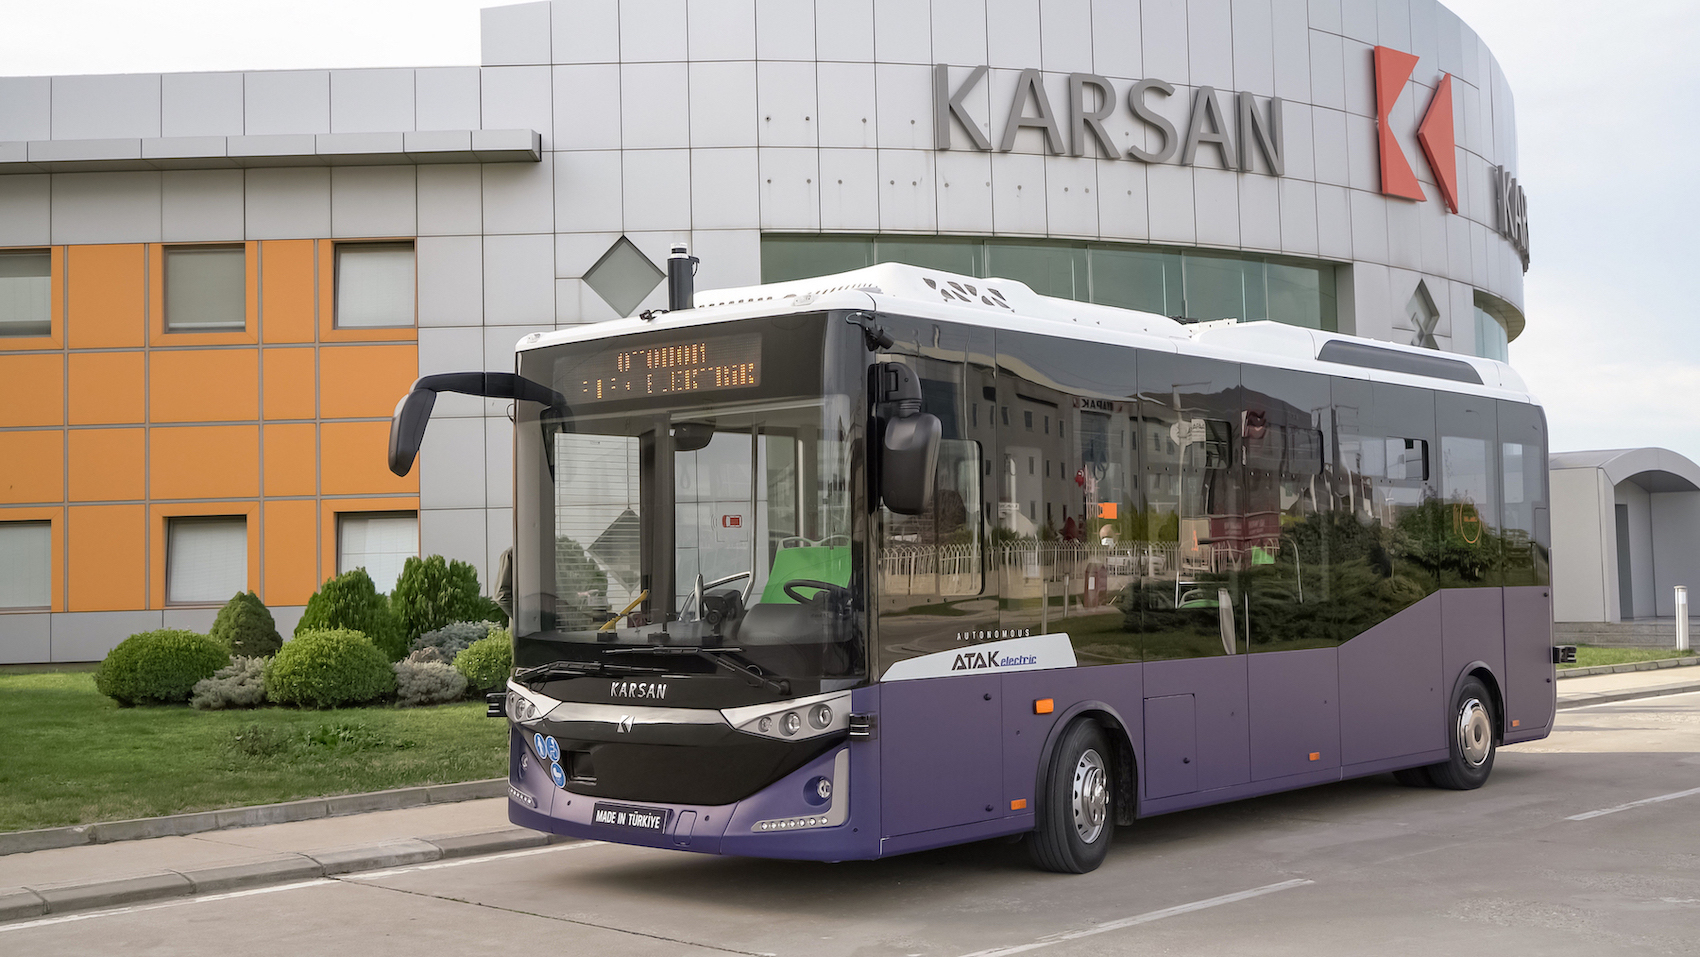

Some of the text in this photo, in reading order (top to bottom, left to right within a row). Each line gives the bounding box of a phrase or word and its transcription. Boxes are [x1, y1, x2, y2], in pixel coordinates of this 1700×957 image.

[936, 63, 1285, 176] KARSAN
[956, 628, 1031, 641] AUTONOMOUS
[951, 650, 1037, 671] ATAK electric
[610, 681, 668, 700] KARSAN
[595, 809, 661, 830] MADE IN TÜRKİYE
